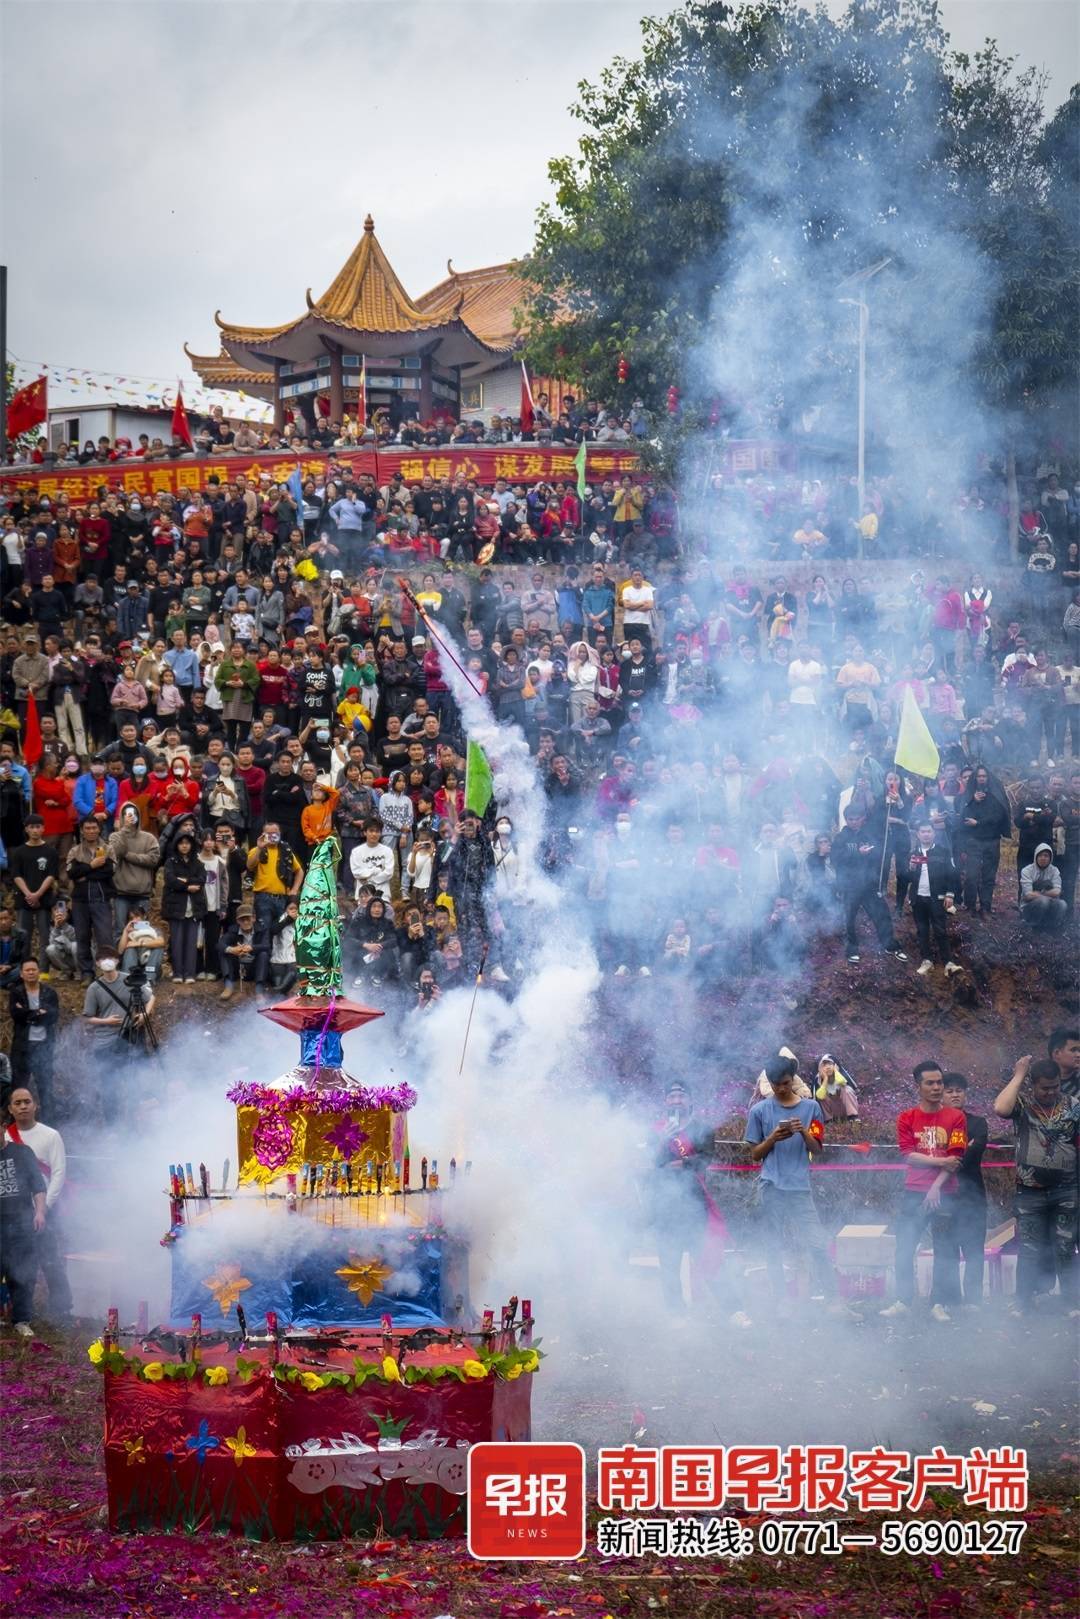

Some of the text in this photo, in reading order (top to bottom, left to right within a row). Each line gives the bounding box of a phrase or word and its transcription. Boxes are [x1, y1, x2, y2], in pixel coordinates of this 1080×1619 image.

[124, 465, 228, 495] 民富国强
[400, 457, 480, 480] 强信心
[494, 454, 576, 478] 谋发展
